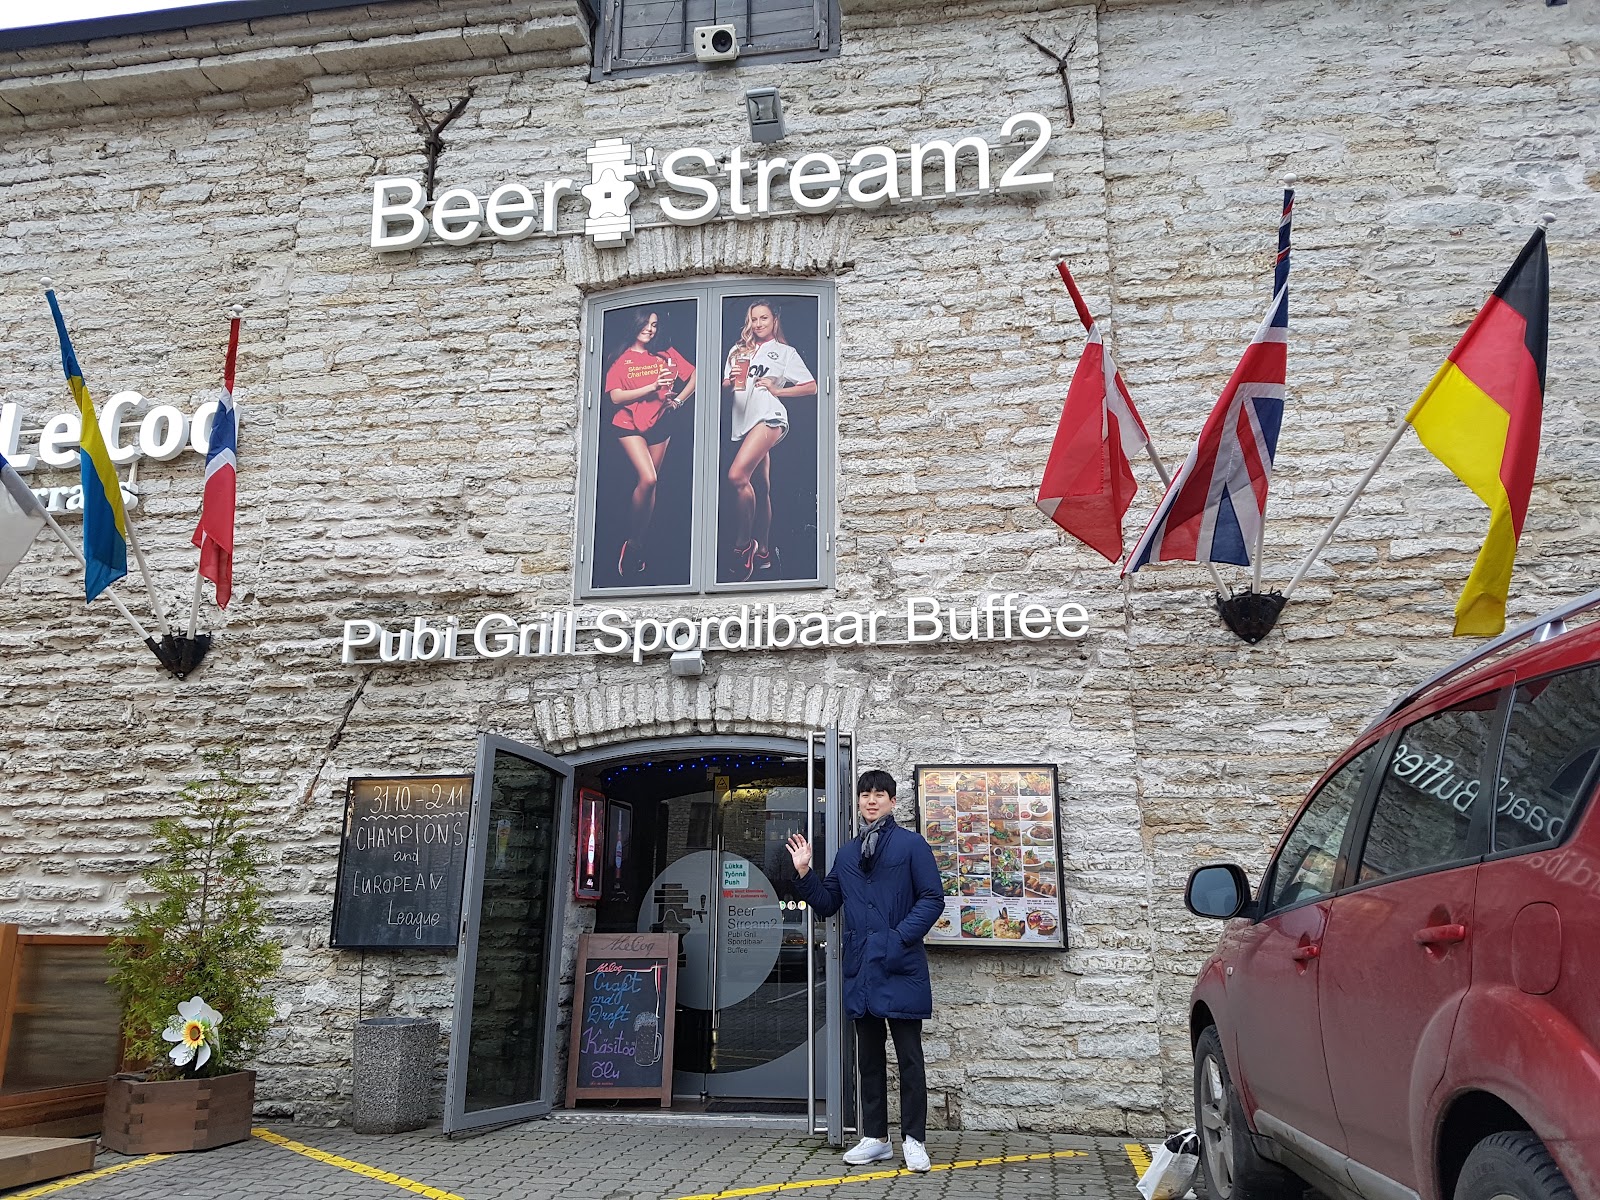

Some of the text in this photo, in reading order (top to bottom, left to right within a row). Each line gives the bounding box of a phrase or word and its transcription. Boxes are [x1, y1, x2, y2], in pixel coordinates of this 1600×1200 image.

[369, 111, 1054, 253] Beer Stream2
[627, 368, 659, 379] Chartered
[628, 363, 658, 373] Standard
[747, 364, 769, 377] ON
[341, 593, 1091, 666] Pubi Grill Spordibaar Buffee
[356, 821, 464, 851] CHAMPIONS
[393, 848, 420, 866] and
[353, 870, 443, 897] EUROPEAN
[387, 900, 440, 940] League
[728, 905, 757, 917] Beer
[727, 918, 778, 930] Stream2
[727, 938, 763, 946] Spordibaar
[727, 946, 748, 954] Buffee
[593, 971, 642, 1005] Craft
[591, 993, 615, 1006] and
[587, 1003, 631, 1029] Draft
[581, 1026, 636, 1057] Käsitöö
